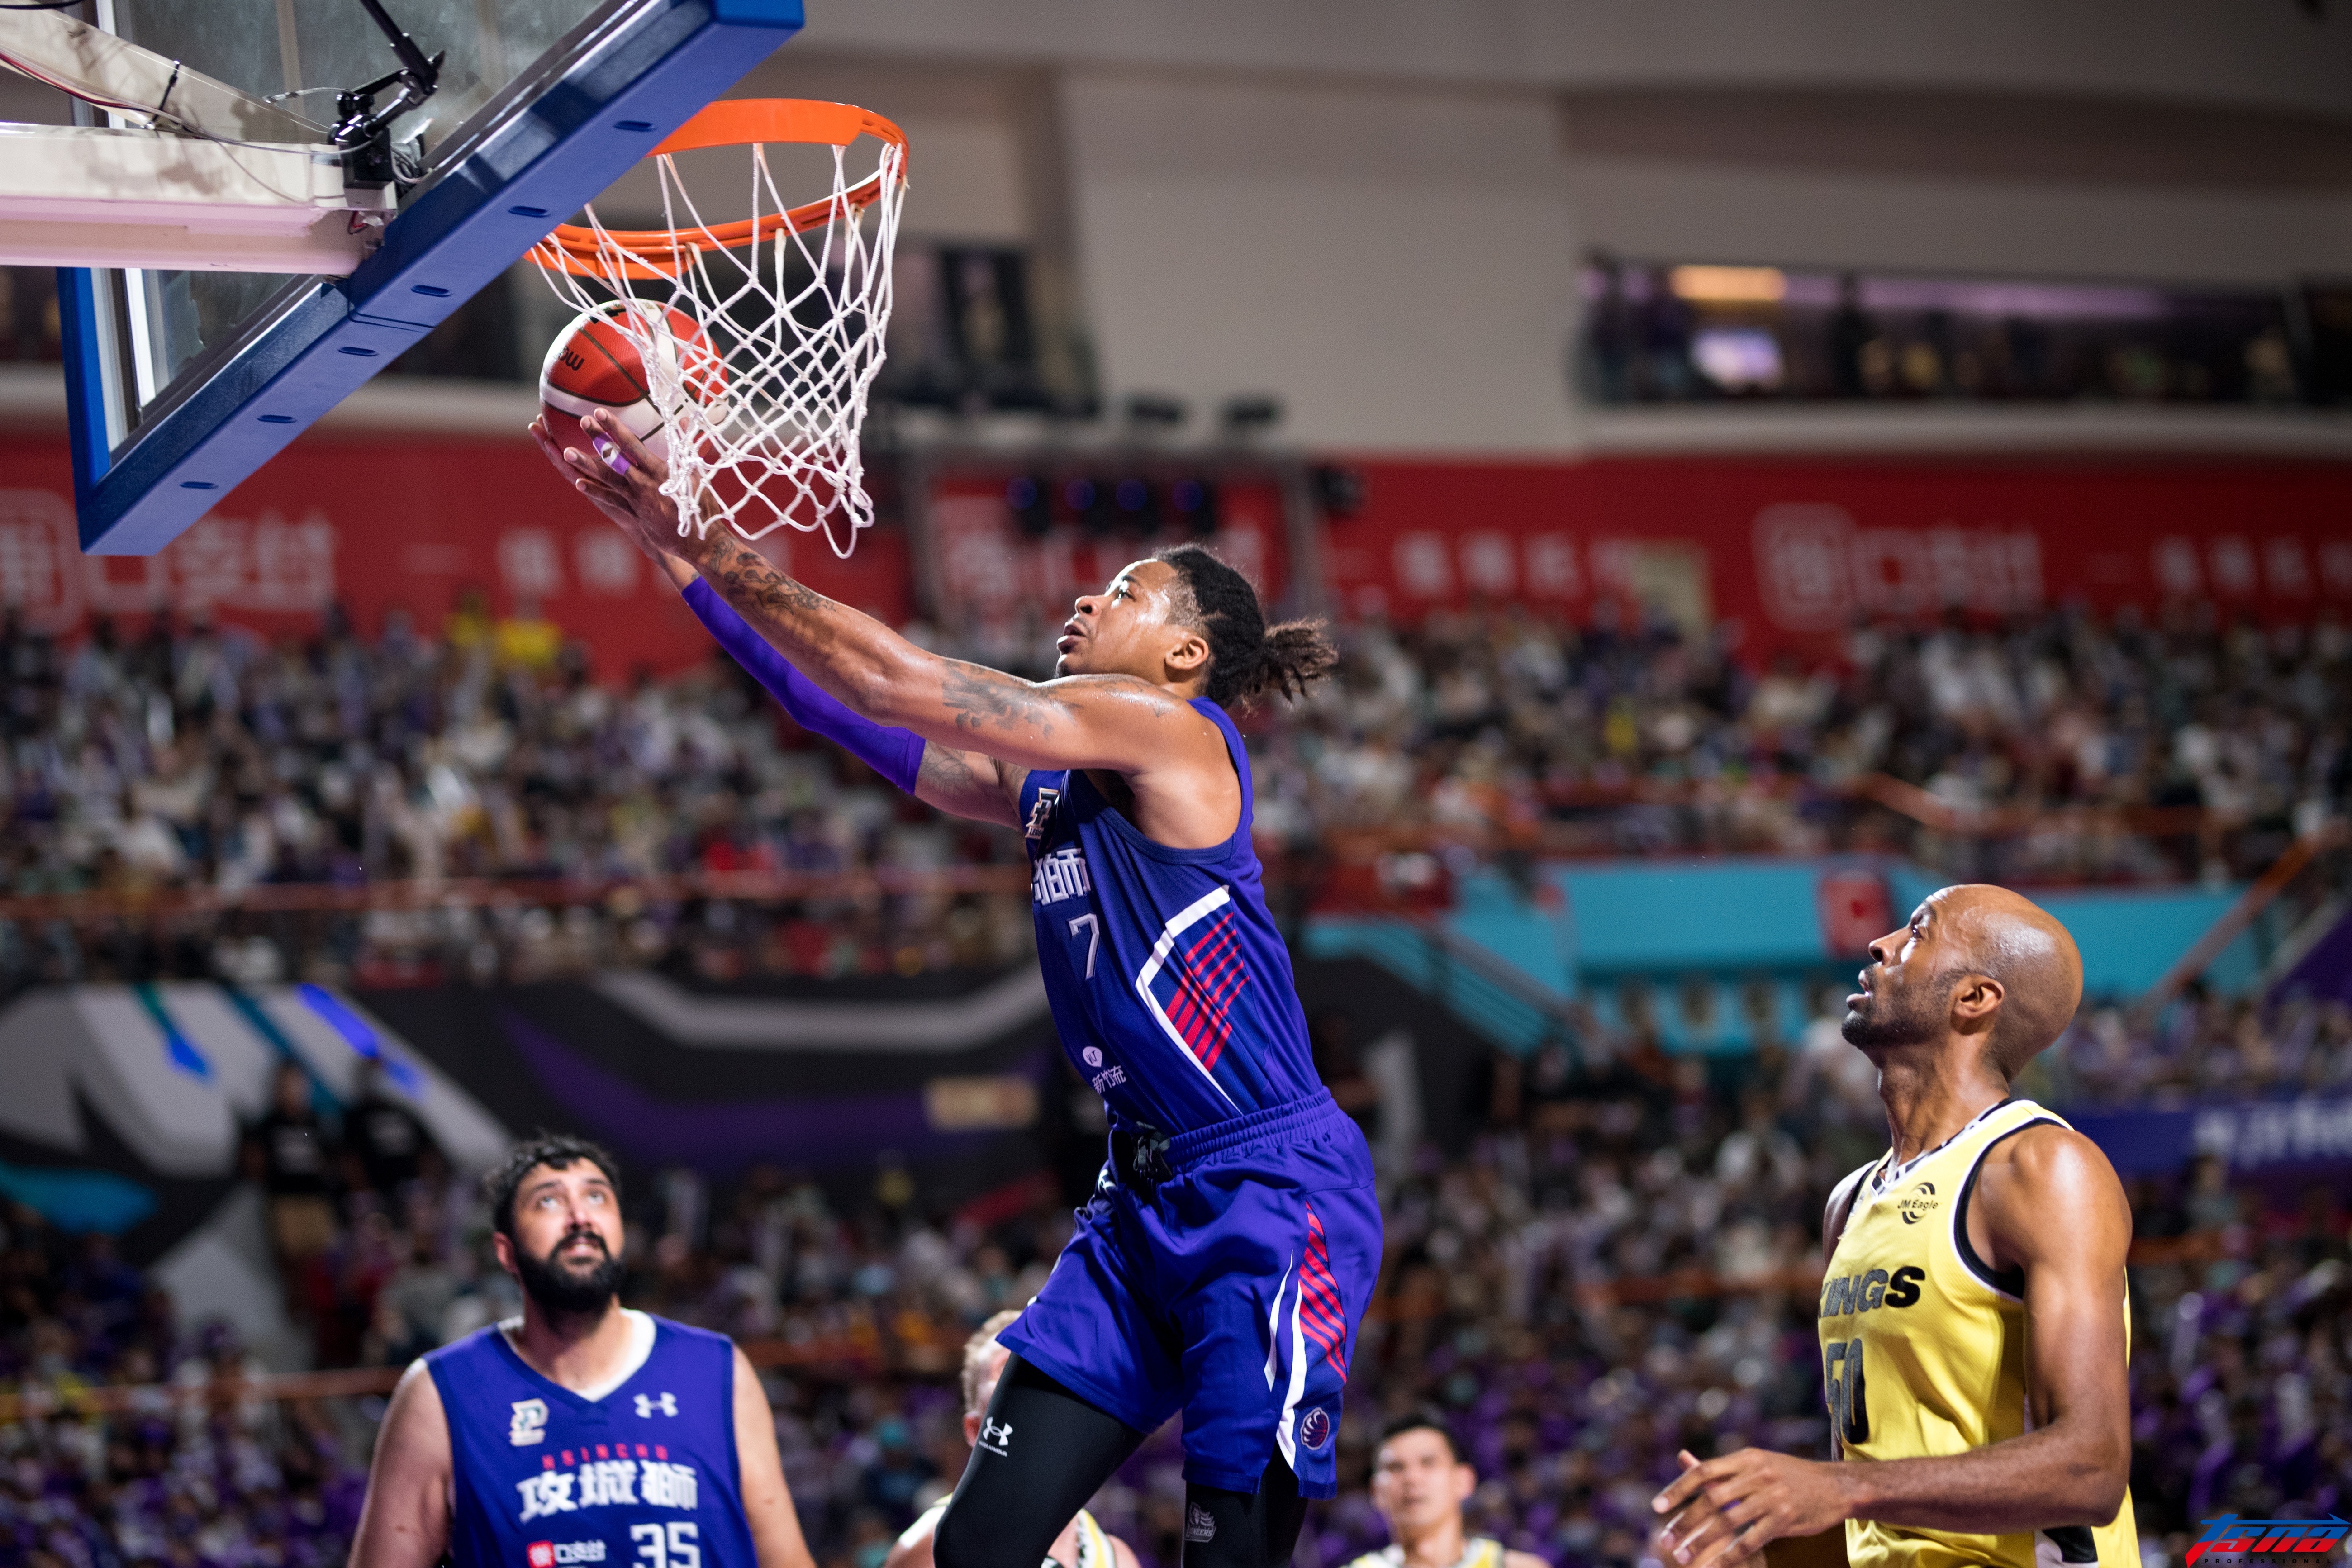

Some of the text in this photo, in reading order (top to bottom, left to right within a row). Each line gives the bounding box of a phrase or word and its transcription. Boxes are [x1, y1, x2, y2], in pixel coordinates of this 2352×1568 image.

[1068, 913, 1099, 981] 7
[1897, 1199, 1938, 1211] JM Eagle
[1826, 1337, 1869, 1445] 50
[515, 1459, 699, 1523] 攻城獅
[630, 1521, 701, 1568] 35
